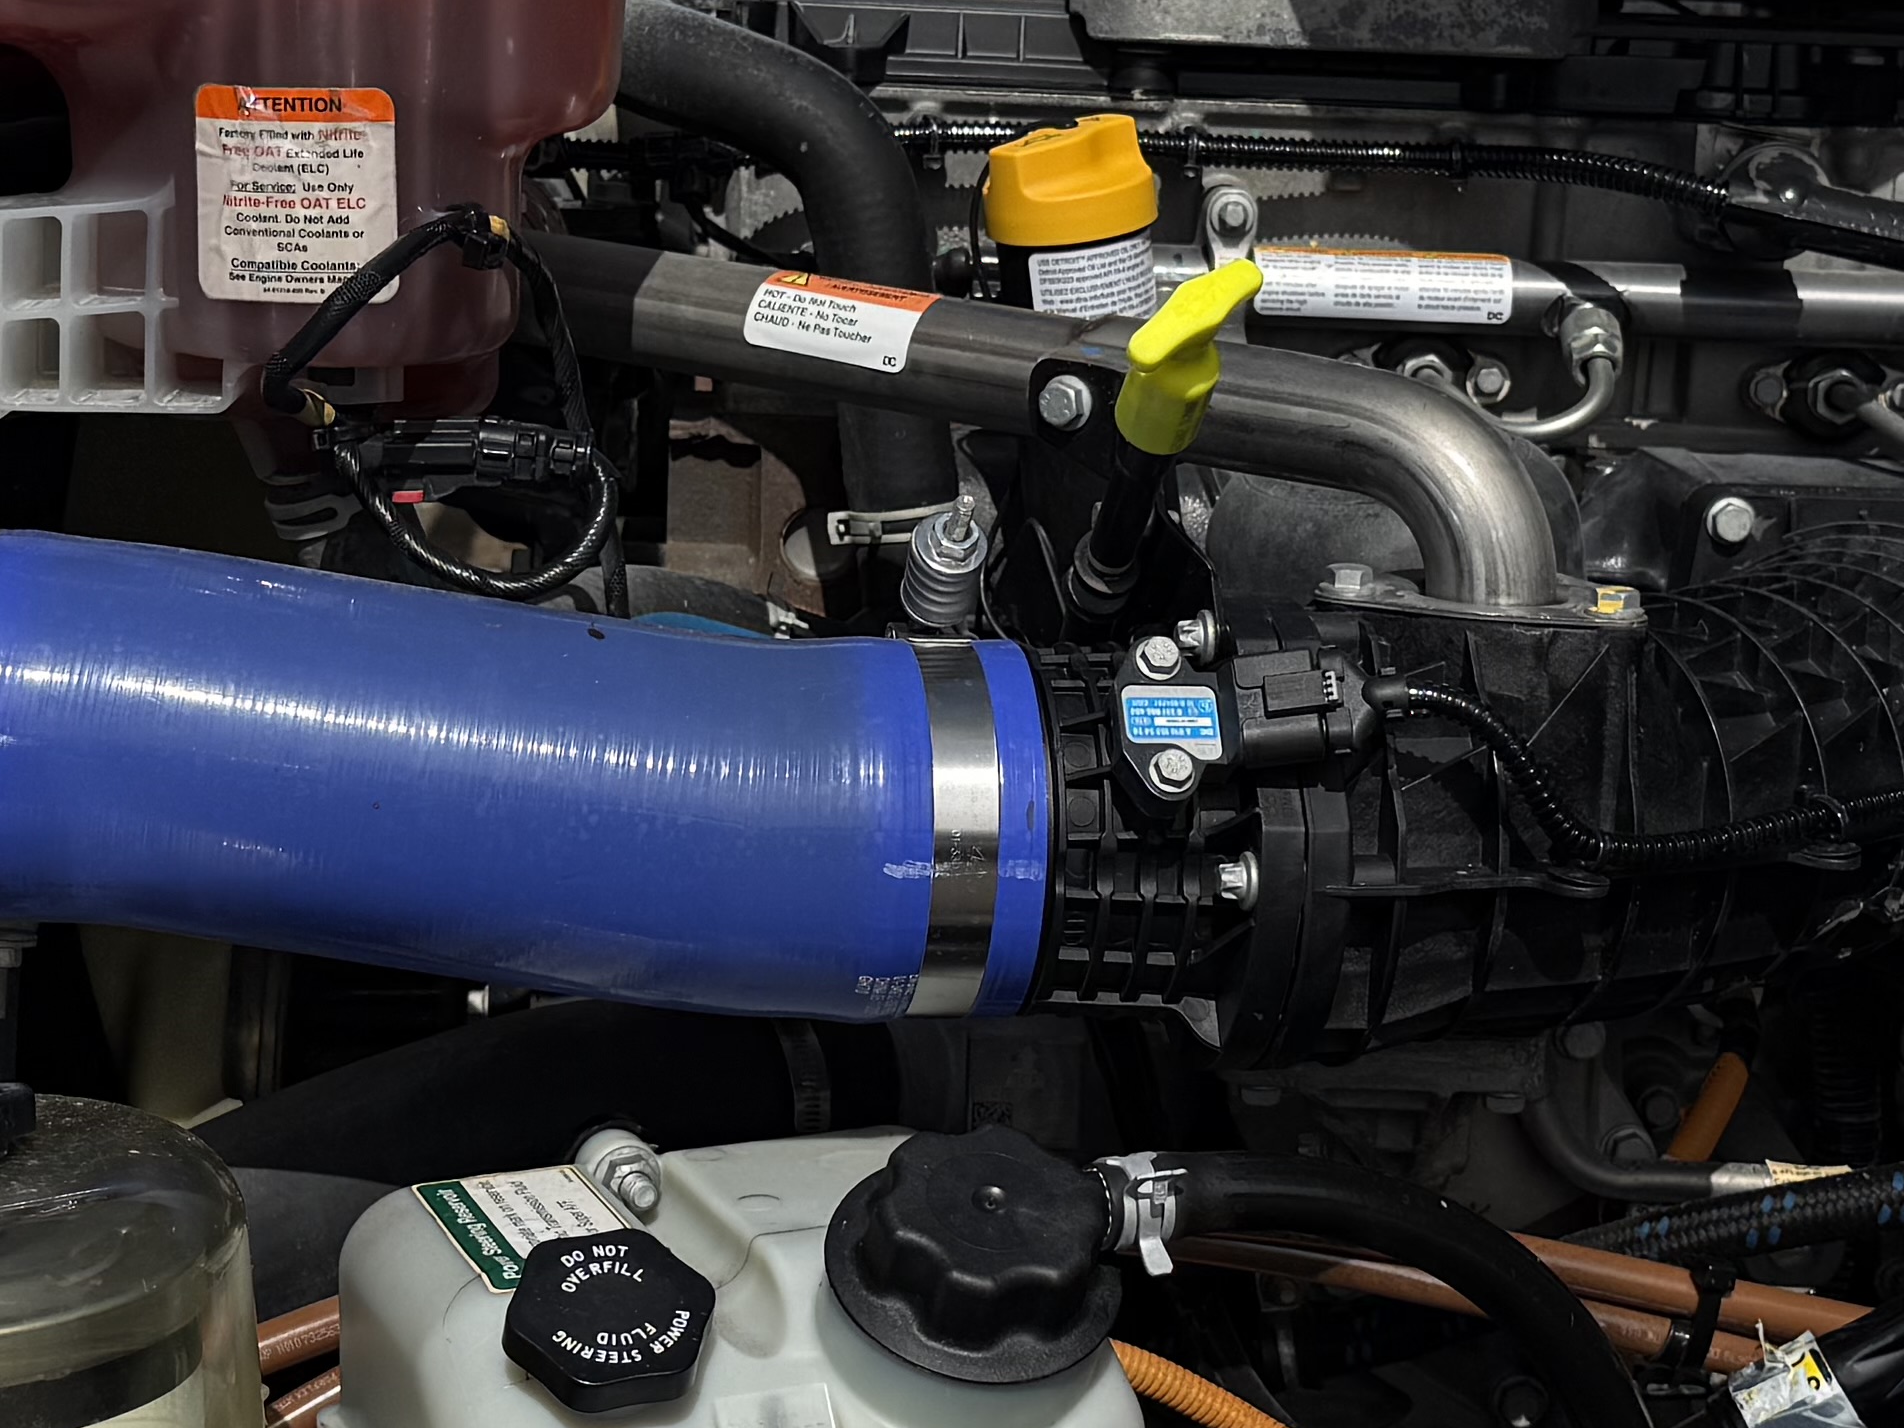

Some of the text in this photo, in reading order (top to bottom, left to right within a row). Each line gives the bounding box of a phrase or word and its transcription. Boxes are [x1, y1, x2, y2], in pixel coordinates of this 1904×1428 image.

[291, 129, 315, 141] with
[253, 145, 283, 158] OAT
[285, 148, 340, 159] Extended
[342, 148, 364, 160] Life
[252, 162, 331, 177] Coolant (ELC)
[230, 179, 250, 192] For
[302, 182, 324, 193] Use
[327, 182, 354, 195] Only
[223, 193, 367, 211] Nitrite-Free OAT ELC
[285, 213, 301, 225] Do
[303, 215, 324, 225] Not
[327, 214, 351, 225] Add
[224, 225, 365, 239] Conventional Coolants or
[276, 242, 308, 253] SCAs
[230, 257, 298, 272] Compatible
[228, 272, 325, 285] See Engine Owners
[763, 287, 787, 301] HOT
[793, 293, 805, 304] Do
[808, 296, 826, 307] Not
[827, 298, 857, 314] Touch
[757, 299, 808, 318] CALIENTE
[815, 310, 829, 322] No
[831, 312, 859, 327] Tocar
[1486, 311, 1504, 321] DC
[753, 311, 790, 328] CHAUD
[797, 320, 812, 332] Ne
[813, 322, 831, 336] Pas
[833, 325, 872, 344] Toucher
[437, 1187, 476, 1224] Reservoir
[467, 1222, 502, 1257] Steering
[559, 1244, 629, 1269] DO NOT
[561, 1260, 646, 1294] OVERFILL
[552, 1309, 691, 1365] POWER STEERING
[596, 1322, 658, 1347] FLUID
